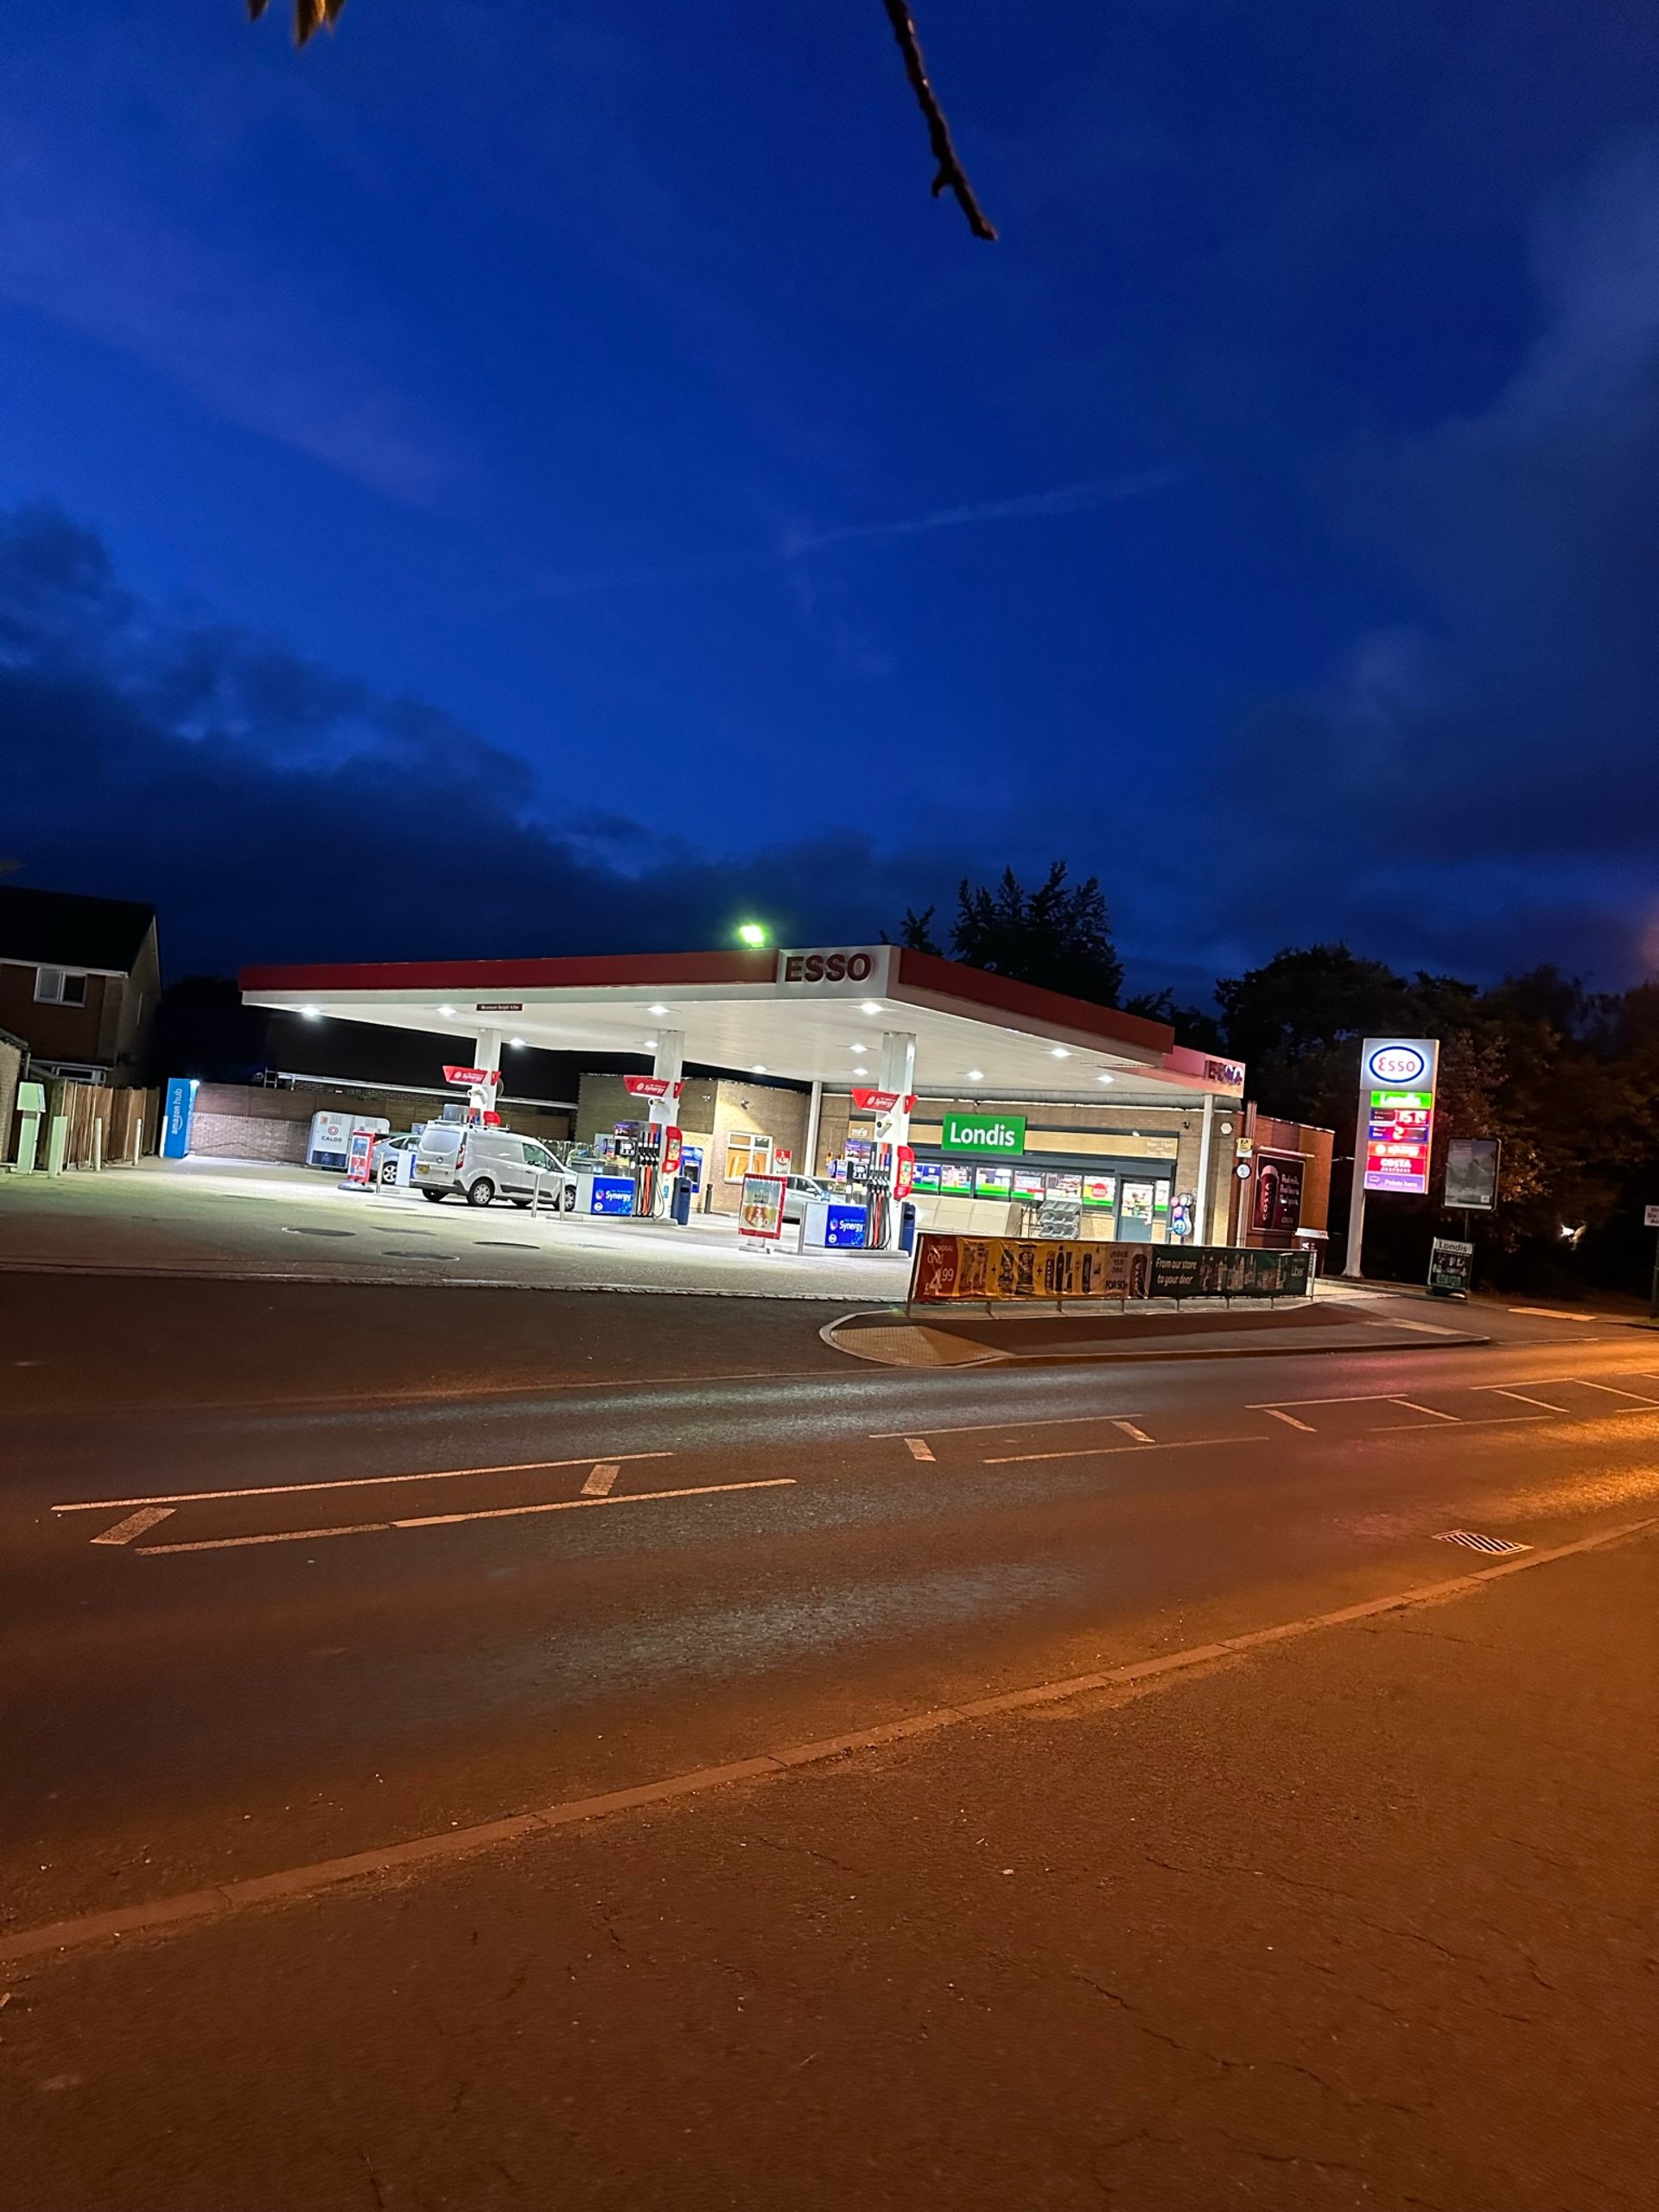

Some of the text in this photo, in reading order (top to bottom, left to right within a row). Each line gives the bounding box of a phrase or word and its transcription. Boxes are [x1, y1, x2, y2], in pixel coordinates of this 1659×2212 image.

[785, 953, 872, 982] ESSO
[644, 1084, 665, 1094] Synergy
[874, 1098, 894, 1108] Synergy
[171, 1088, 182, 1135] amazon hub
[950, 1122, 1015, 1147] Londis
[1380, 1158, 1412, 1168] COSTA
[605, 1190, 632, 1202] Synergy
[839, 1219, 864, 1233] Synergy
[1439, 1241, 1468, 1252] Londis
[1155, 1257, 1197, 1270] From our store
[1291, 1266, 1304, 1277] Uber
[1106, 1281, 1117, 1290] FOR
[1158, 1274, 1193, 1287] to your door
